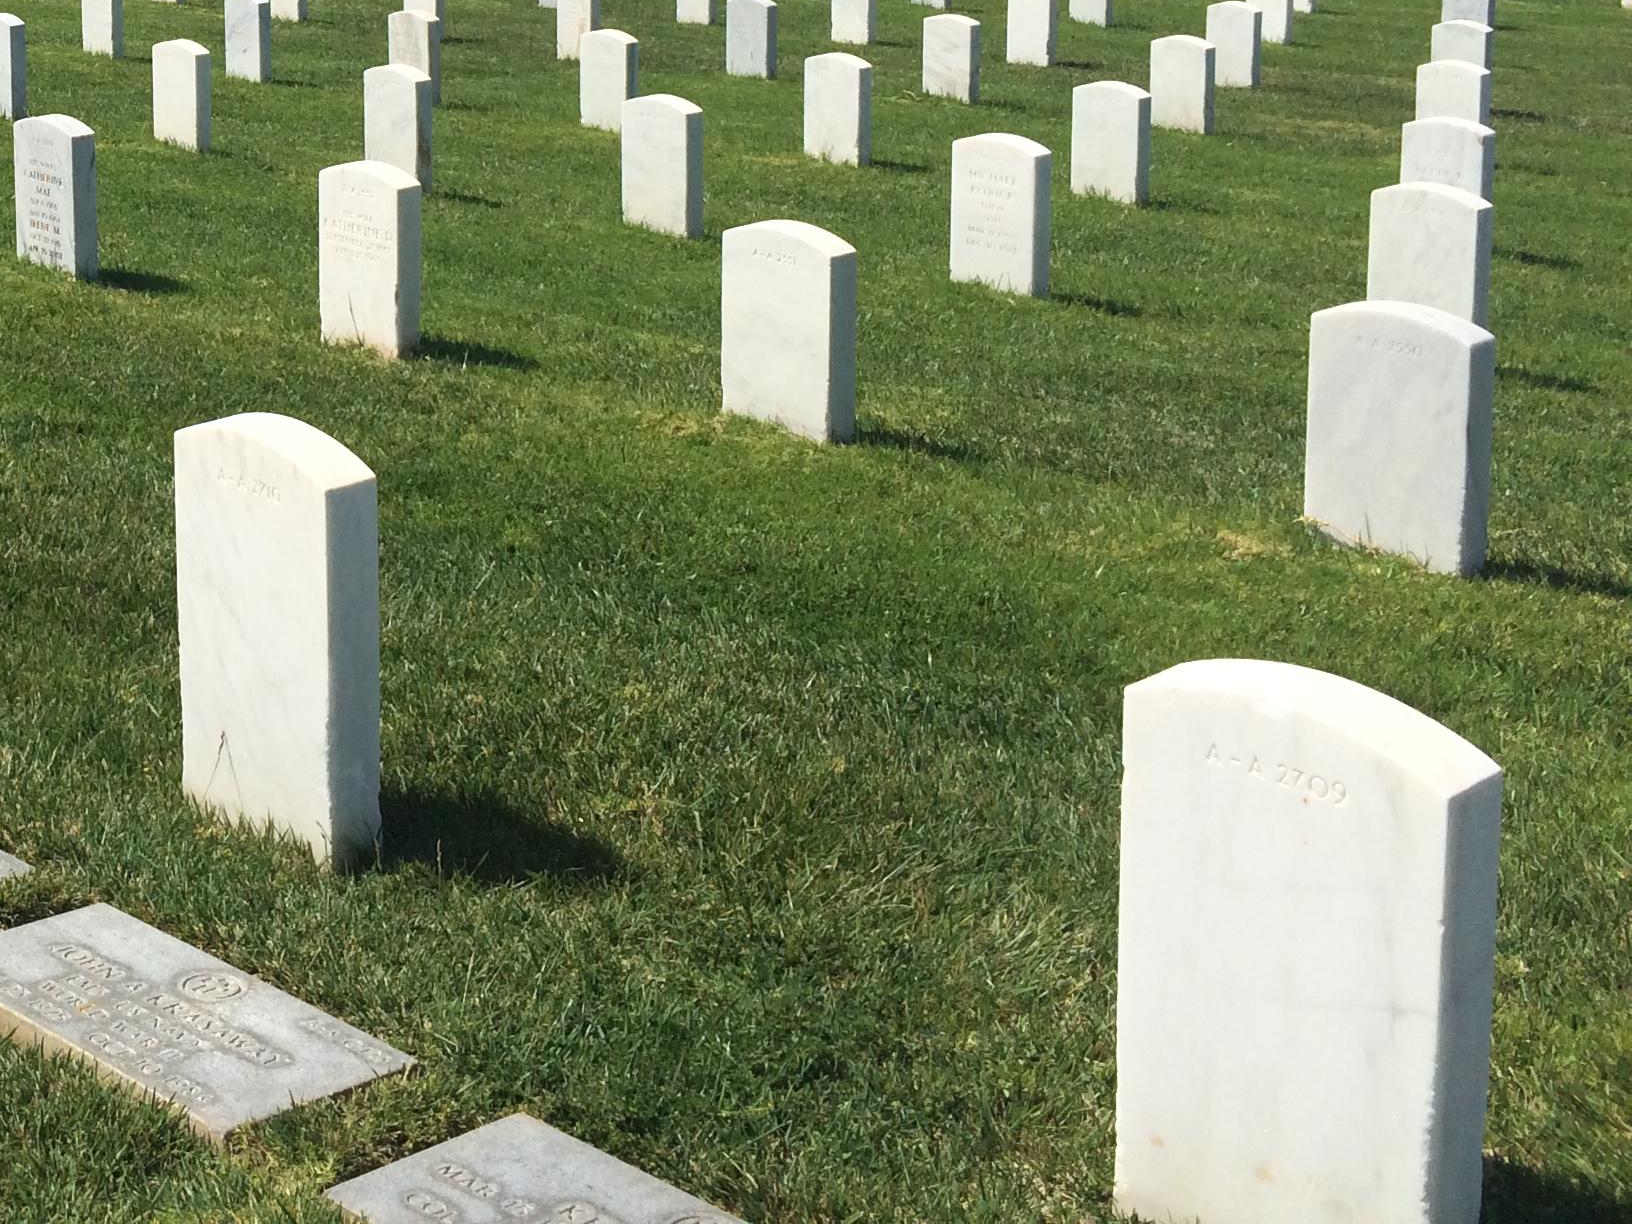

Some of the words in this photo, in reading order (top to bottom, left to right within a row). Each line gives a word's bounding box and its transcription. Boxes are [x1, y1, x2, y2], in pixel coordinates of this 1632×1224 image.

[24, 168, 62, 187] CATHERINE
[968, 169, 1015, 185] MICHAEL
[36, 185, 51, 197] MAE
[970, 185, 1013, 198] PATRICK
[30, 219, 50, 232] IRENE
[323, 217, 380, 238] KATHERINE
[252, 478, 281, 502] 2710
[1205, 742, 1268, 781] A-A
[1276, 763, 1348, 808] 2709
[35, 980, 112, 1020] WORLD
[107, 1020, 161, 1048] WAR
[46, 941, 125, 981] JOHN
[121, 980, 150, 994] A
[146, 994, 288, 1069] KRASAWAY
[139, 1015, 207, 1051] NAVY
[82, 1031, 135, 1058] OCT
[127, 1058, 167, 1076] 10
[434, 1163, 503, 1198] MAR
